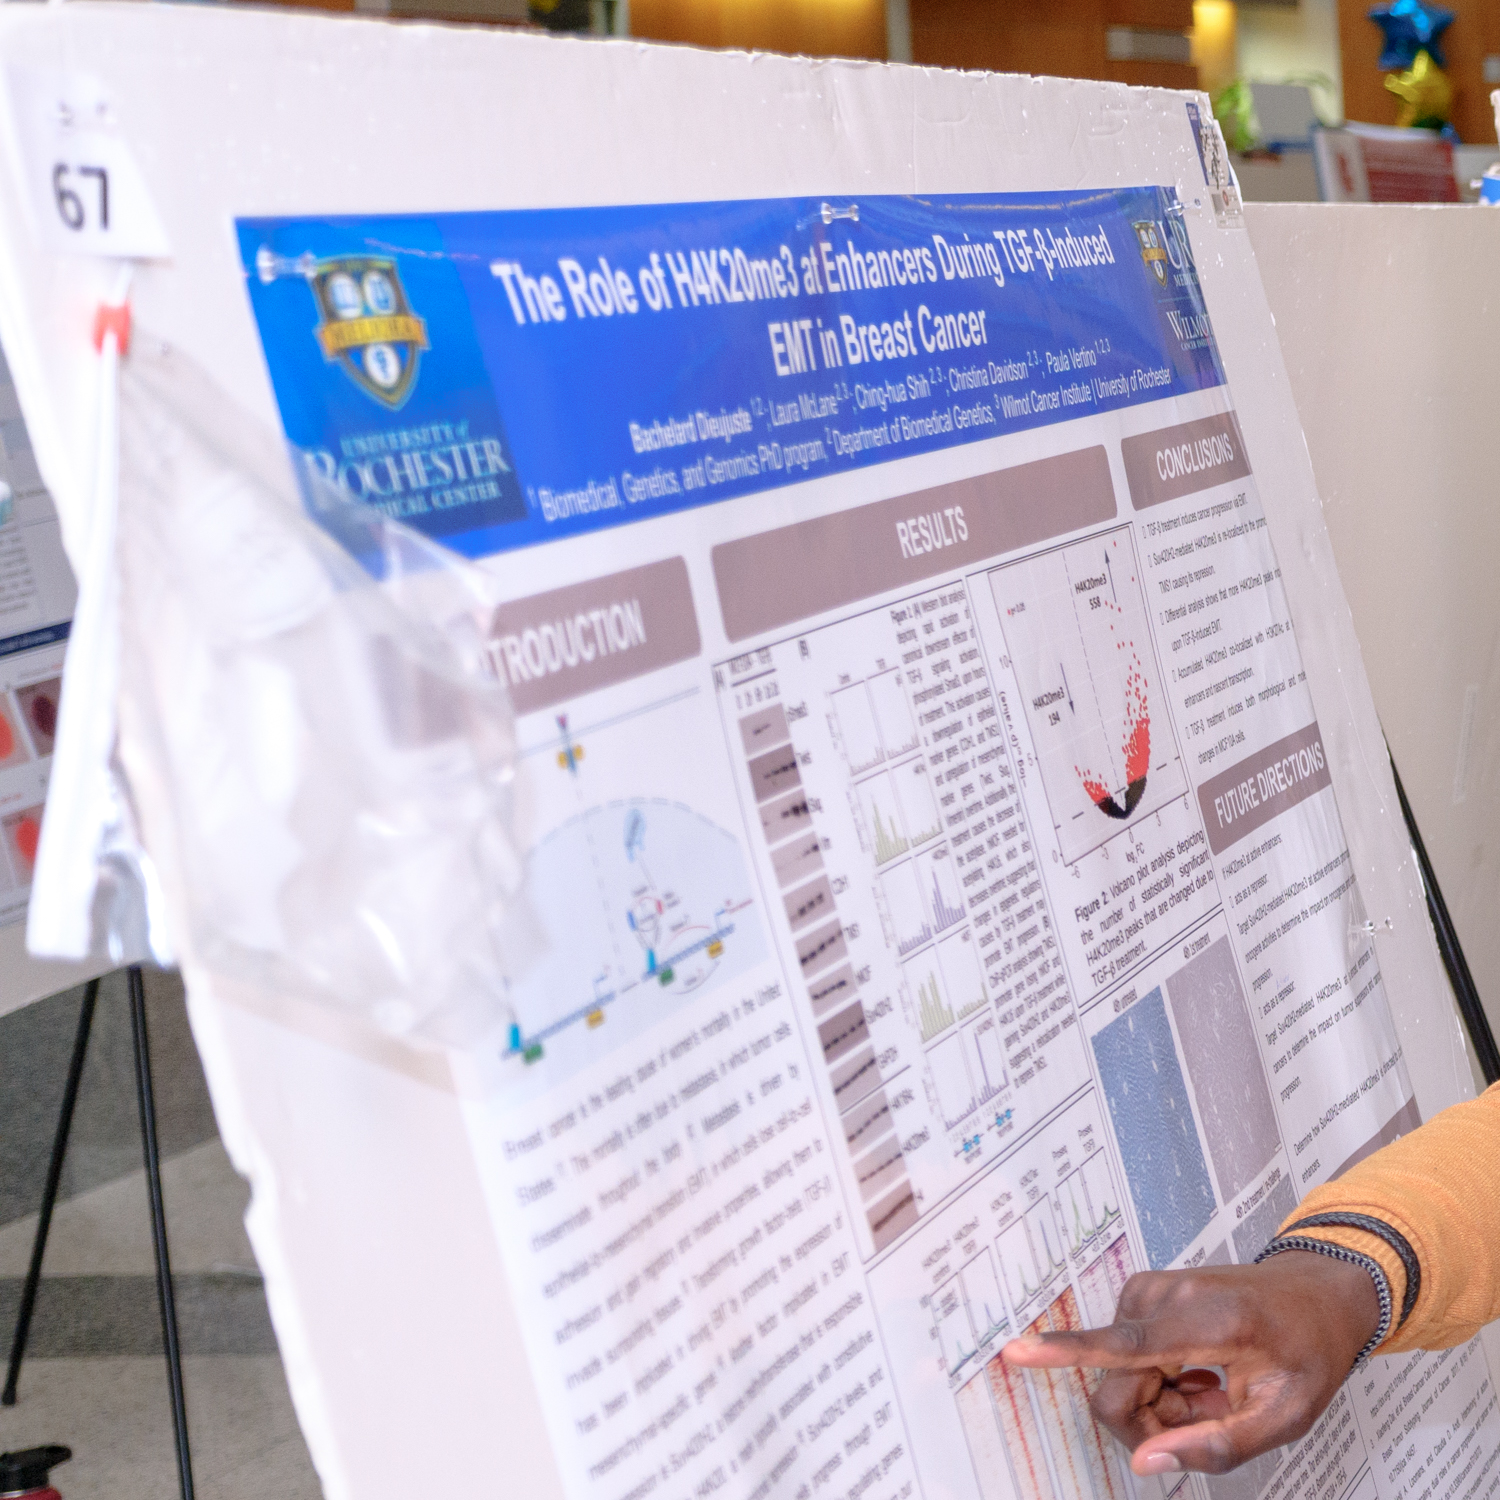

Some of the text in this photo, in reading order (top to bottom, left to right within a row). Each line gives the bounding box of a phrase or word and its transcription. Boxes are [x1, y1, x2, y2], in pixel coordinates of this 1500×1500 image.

[53, 162, 111, 230] 67
[492, 226, 1114, 323] The Role of H4K20me3 at Enhancers During TGF-β-Induced
[767, 305, 987, 376] EMT in Breast Cancer
[906, 374, 930, 399] Shih
[948, 366, 988, 391] Christina
[988, 360, 1028, 384] Davidson
[1045, 351, 1070, 372] Paula
[1068, 347, 1096, 368] Vertino
[682, 461, 705, 489] and
[757, 442, 782, 469] PhD
[889, 417, 901, 443] of
[900, 410, 952, 439] Biomedical
[1000, 394, 1031, 417] Wilmot
[1030, 390, 1059, 412] Cancer
[1060, 383, 1091, 405] Institute
[1094, 374, 1129, 398] University
[1129, 370, 1138, 391] of
[1136, 367, 1170, 388] Rochester
[1156, 432, 1234, 482] CONCLUSIONS
[896, 505, 970, 556] RESULTS
[481, 598, 647, 690] TRODUCTION
[1214, 741, 1325, 828] FUTURE DIRECTIONS
[1074, 898, 1100, 921] Figure
[1109, 874, 1135, 897] Volcano
[1136, 863, 1149, 884] plot
[1150, 848, 1175, 871] analysis
[1176, 830, 1204, 854] depicting
[1080, 849, 1209, 944] the number of statistically significant
[1086, 869, 1214, 964] H4K20me3 peaks that are changed due to
[1091, 940, 1146, 985] TGF-β treatment.
